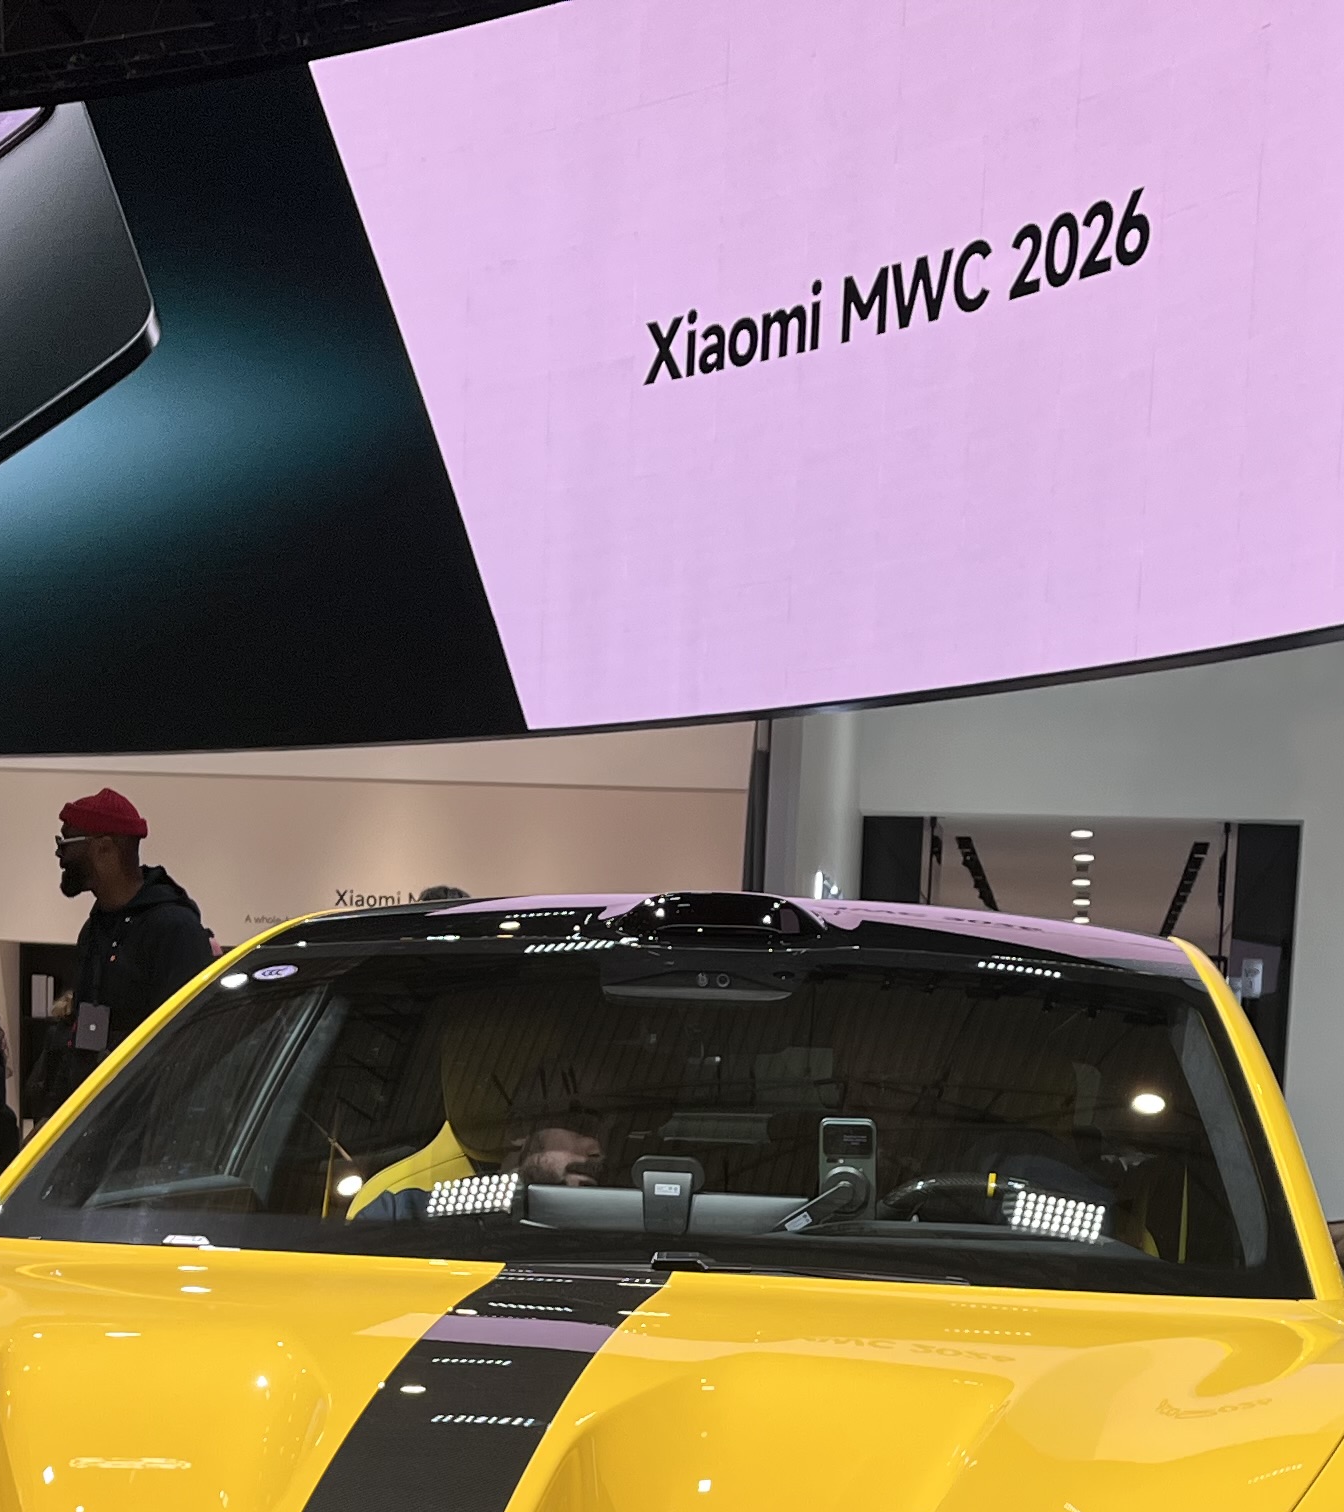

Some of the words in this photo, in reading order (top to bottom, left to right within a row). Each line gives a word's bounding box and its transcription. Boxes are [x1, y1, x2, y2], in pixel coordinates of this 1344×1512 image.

[643, 279, 822, 386] Xiaomi
[840, 239, 992, 344] MWC
[1008, 187, 1150, 301] 2026
[334, 888, 402, 908] Xiaomi
